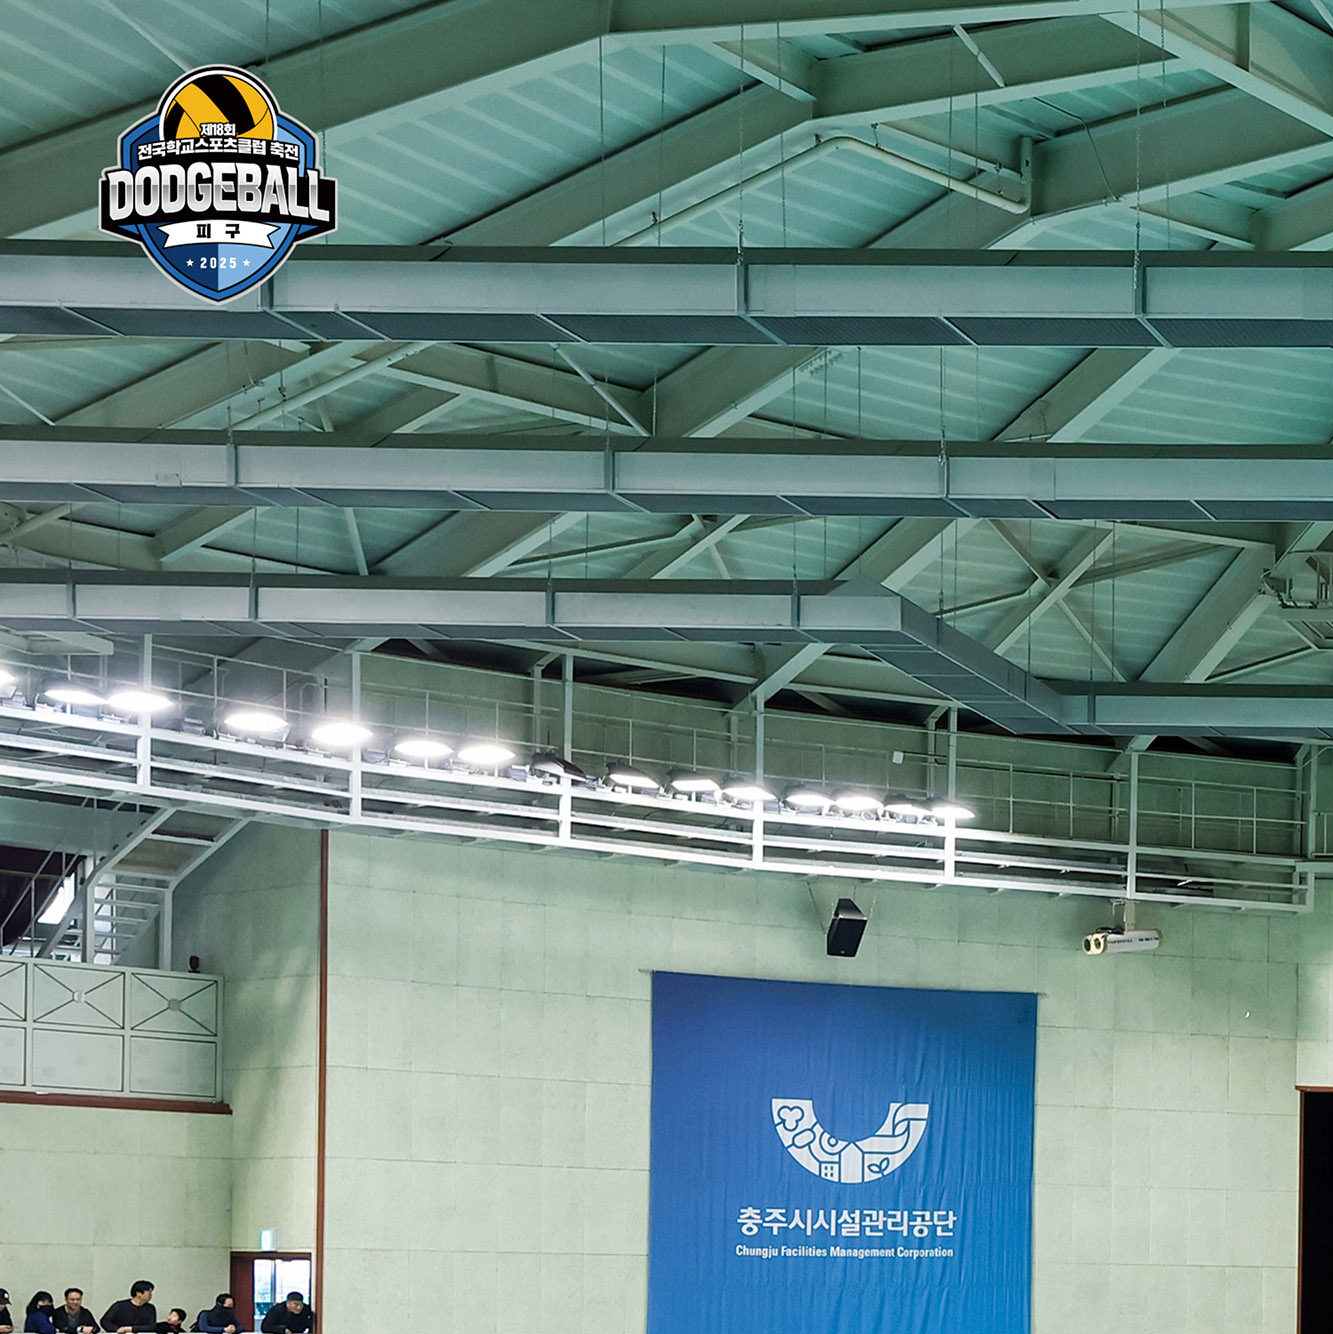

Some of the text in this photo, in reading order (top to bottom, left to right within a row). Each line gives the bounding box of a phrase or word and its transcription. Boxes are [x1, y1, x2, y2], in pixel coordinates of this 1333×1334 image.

[737, 1206, 957, 1238] 충주시시설관리공단
[736, 1244, 954, 1260] Chungju Facilities Management Corporation
